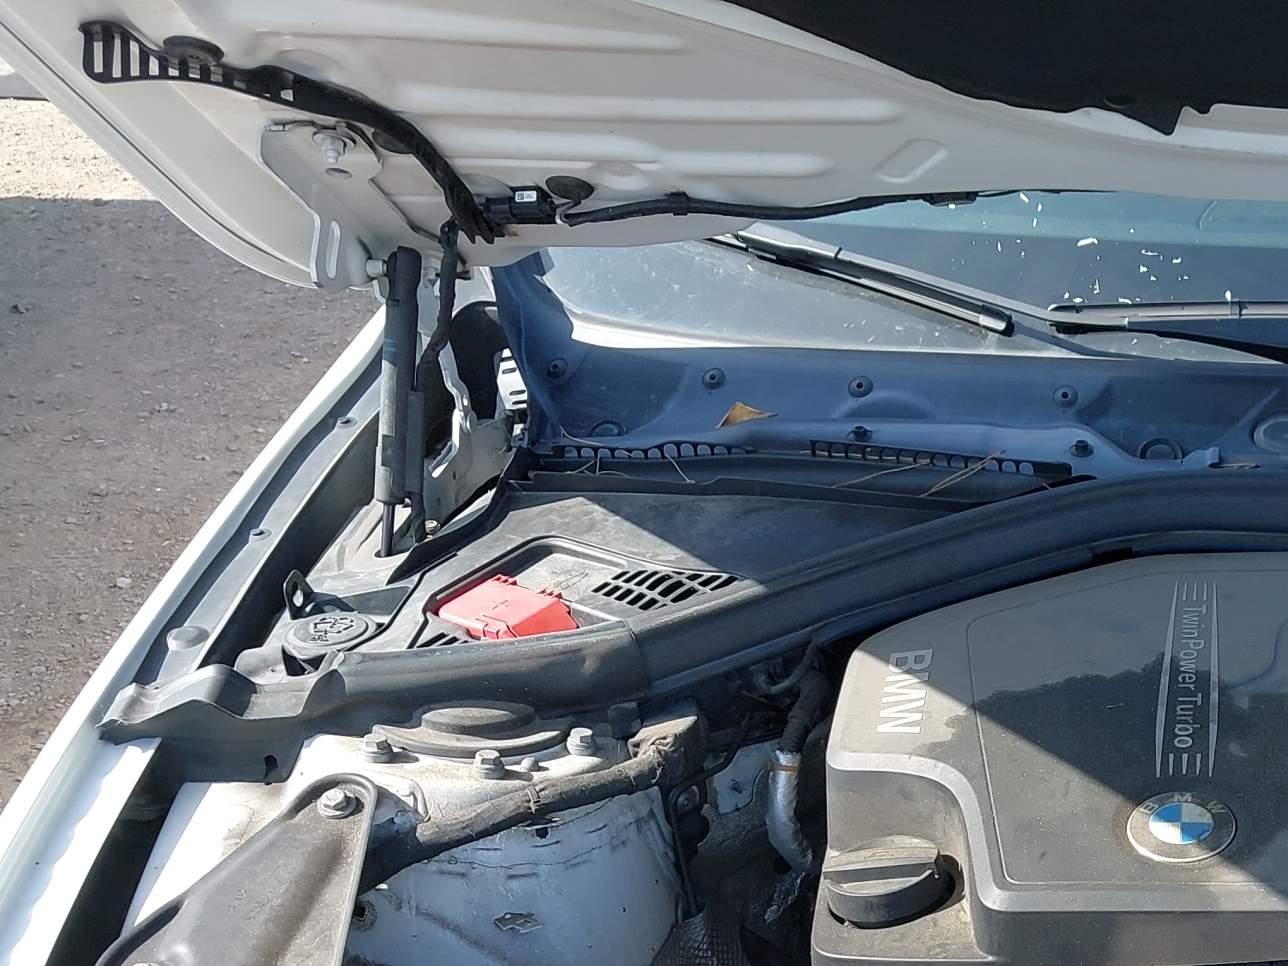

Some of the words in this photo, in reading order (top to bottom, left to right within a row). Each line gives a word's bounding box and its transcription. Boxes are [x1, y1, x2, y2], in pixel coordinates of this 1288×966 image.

[1178, 604, 1207, 690] TwinPower
[876, 648, 933, 734] BMW
[1174, 692, 1203, 748] Turbo
[1139, 793, 1228, 815] BMW
